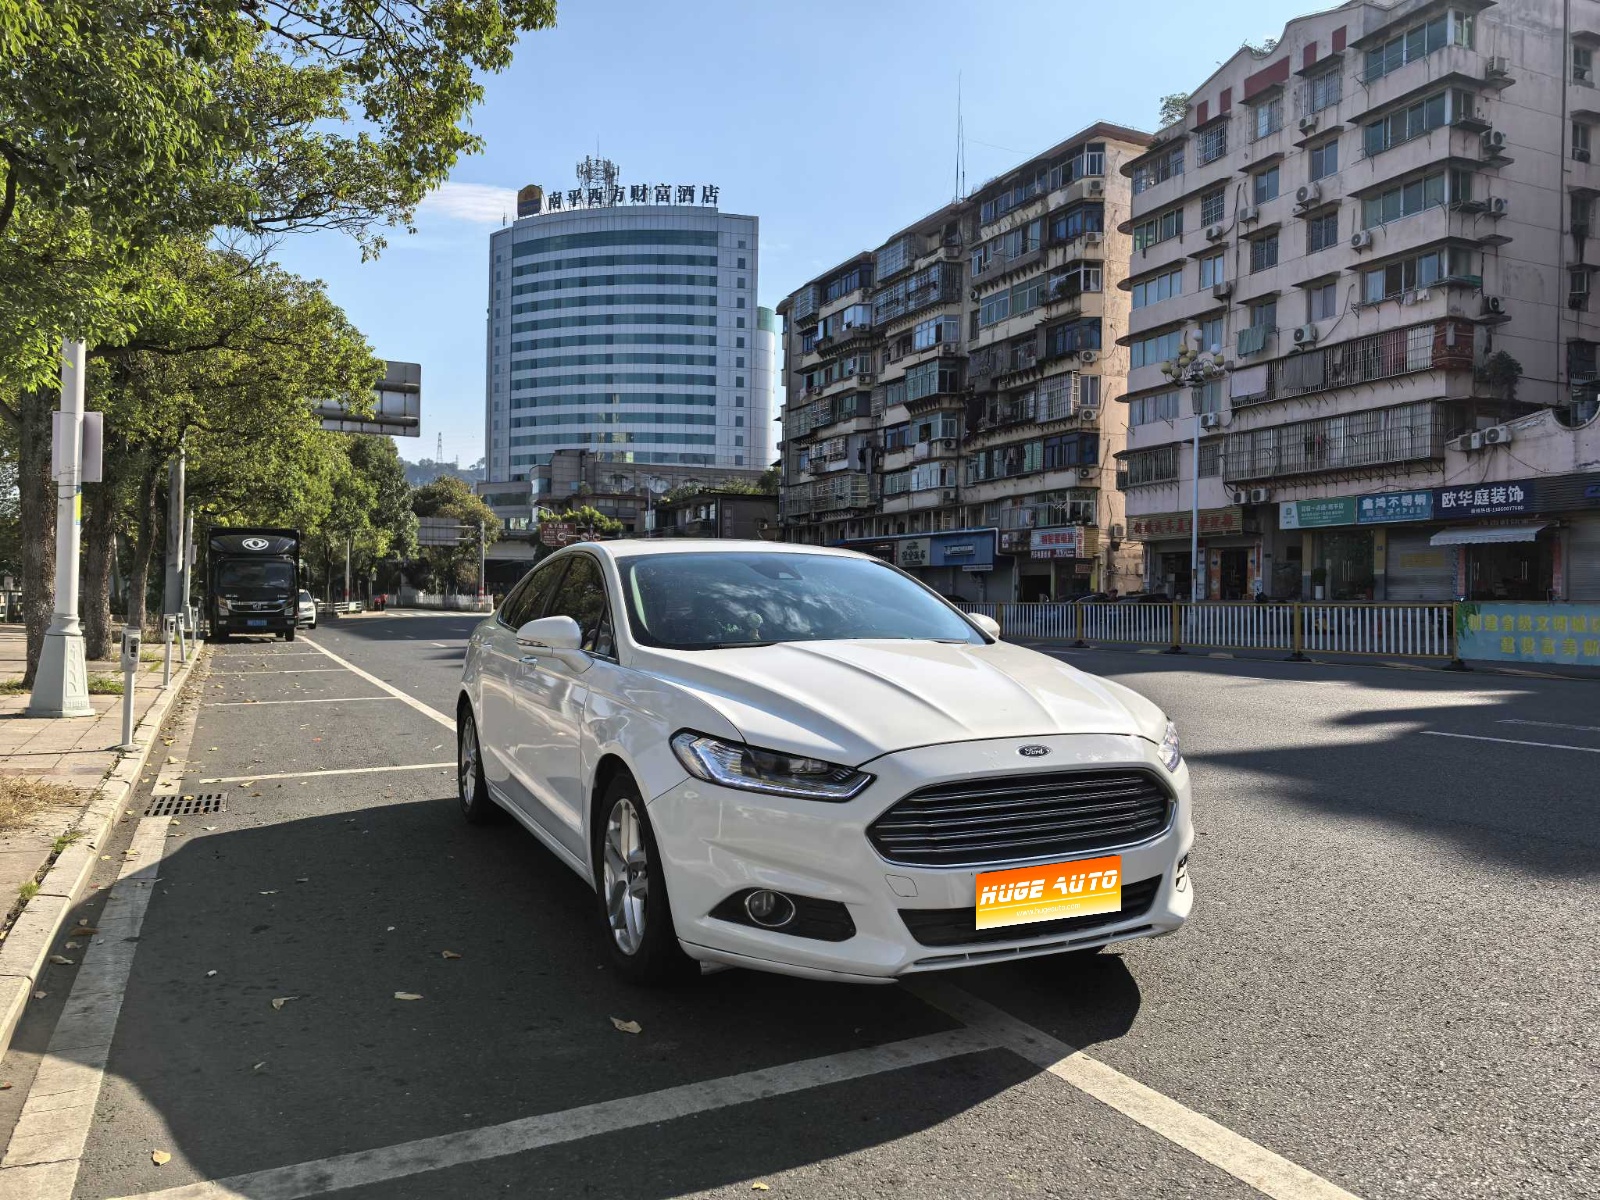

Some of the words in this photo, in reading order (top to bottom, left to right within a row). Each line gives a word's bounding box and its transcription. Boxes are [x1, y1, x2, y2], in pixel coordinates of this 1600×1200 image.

[548, 183, 720, 210] 南平西方财富酒店
[1441, 485, 1525, 508] 欧华庭装饰
[1024, 747, 1045, 755] Ford
